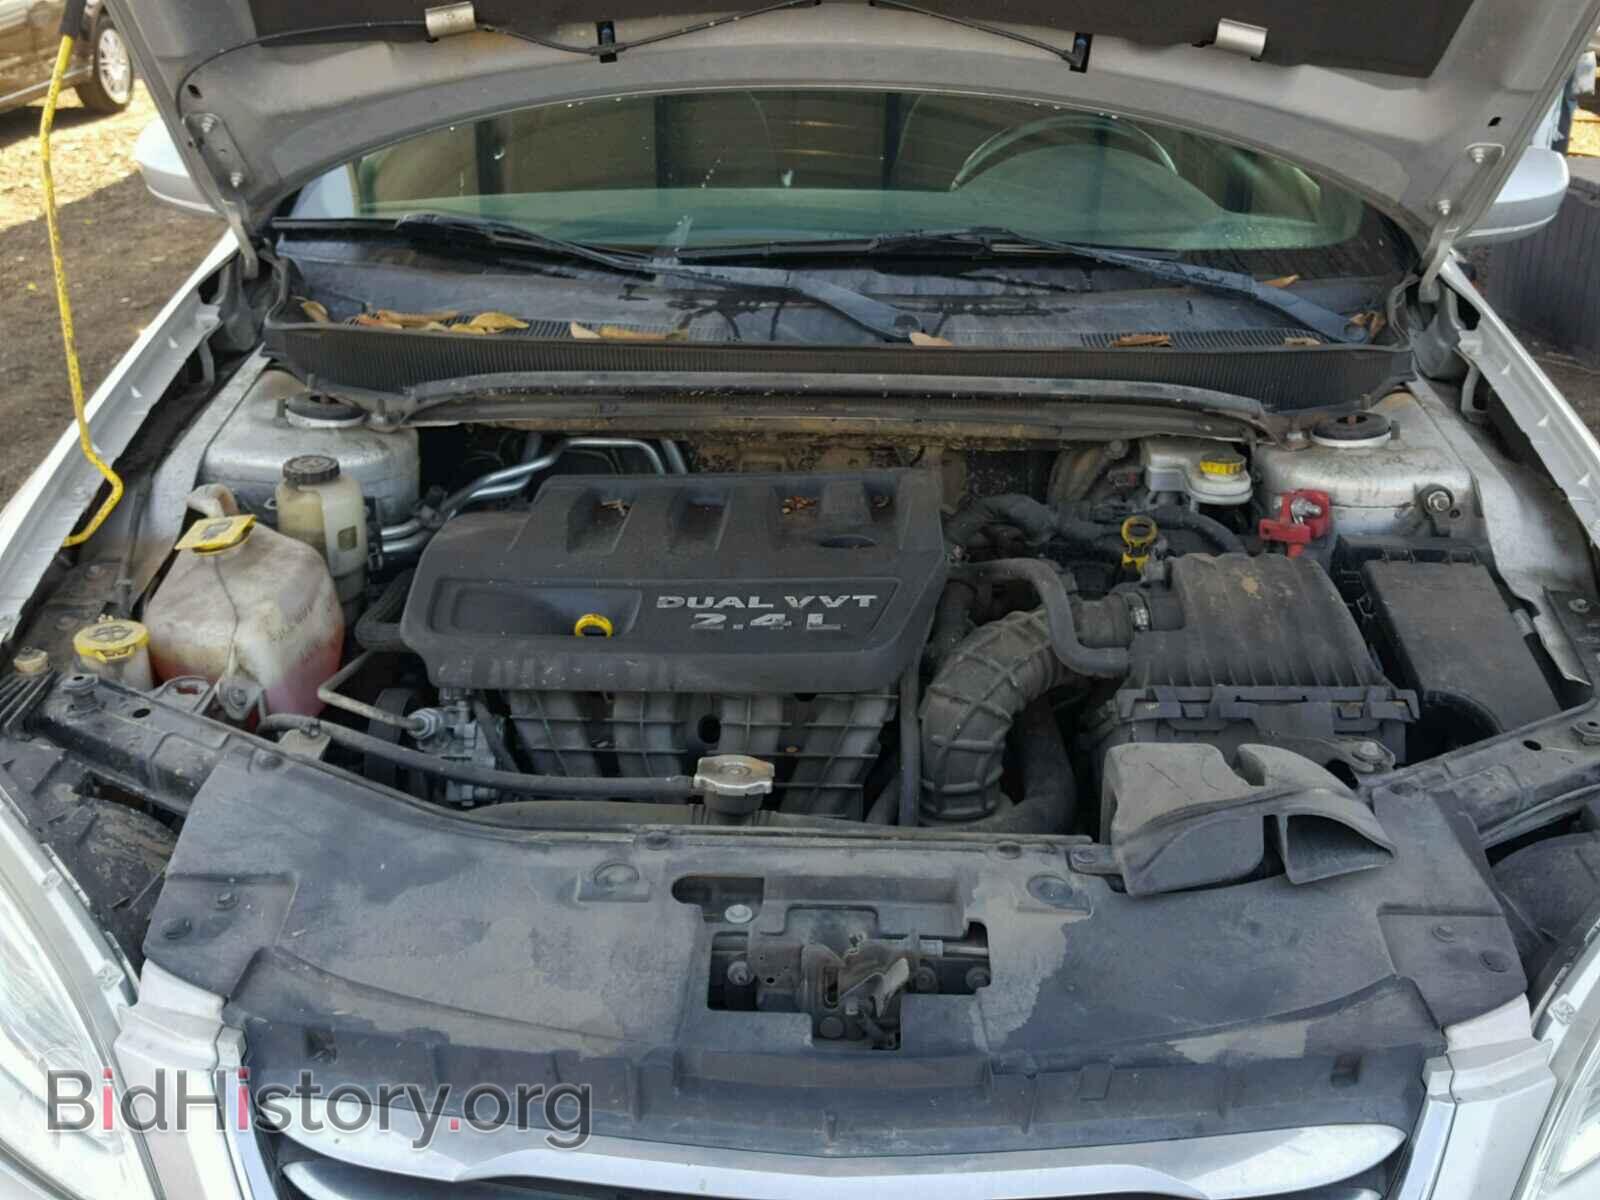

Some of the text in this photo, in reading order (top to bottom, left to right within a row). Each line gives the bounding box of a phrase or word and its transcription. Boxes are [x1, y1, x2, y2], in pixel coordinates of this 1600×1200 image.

[656, 594, 878, 609] DUAL VVT
[690, 613, 792, 630] 2.4
